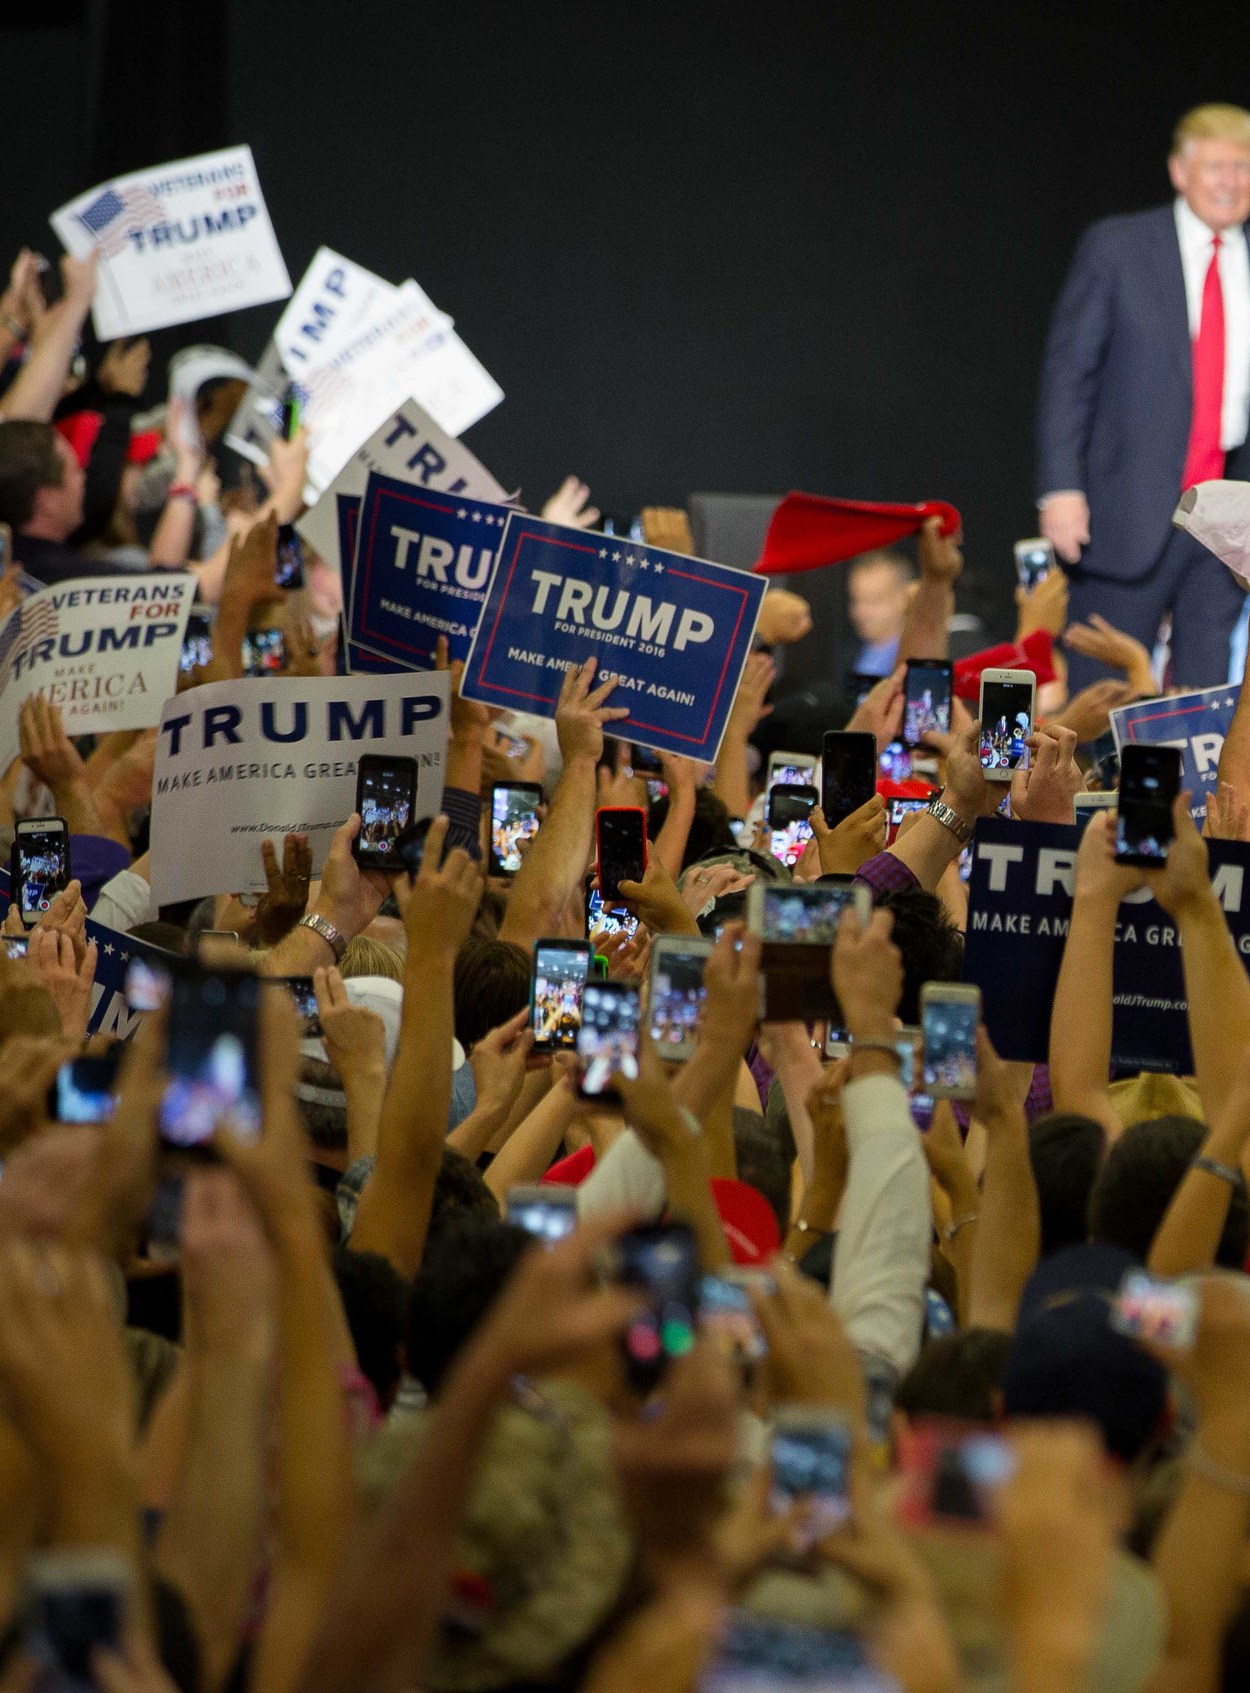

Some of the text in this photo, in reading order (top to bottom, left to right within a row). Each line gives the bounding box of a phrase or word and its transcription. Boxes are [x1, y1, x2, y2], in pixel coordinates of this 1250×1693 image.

[129, 205, 257, 252] TRUMP
[390, 525, 497, 590] TRU
[52, 583, 186, 611] VETERANS
[416, 576, 440, 591] FOR
[130, 602, 180, 620] FOR
[379, 598, 412, 619] MAKE
[413, 611, 467, 636] AMERICA
[530, 569, 715, 651] TRUMP
[12, 622, 178, 681] TRUMP
[554, 621, 666, 658] FOR PRESIDENT 2016
[55, 664, 95, 678] MAKE
[507, 646, 544, 666] MAKE
[647, 682, 696, 706] AGAIN!
[161, 695, 443, 757] TRUMP
[156, 770, 202, 796] MAKE
[207, 762, 297, 785] AMERICA
[1201, 771, 1217, 783] FO
[972, 911, 1031, 934] MAKE
